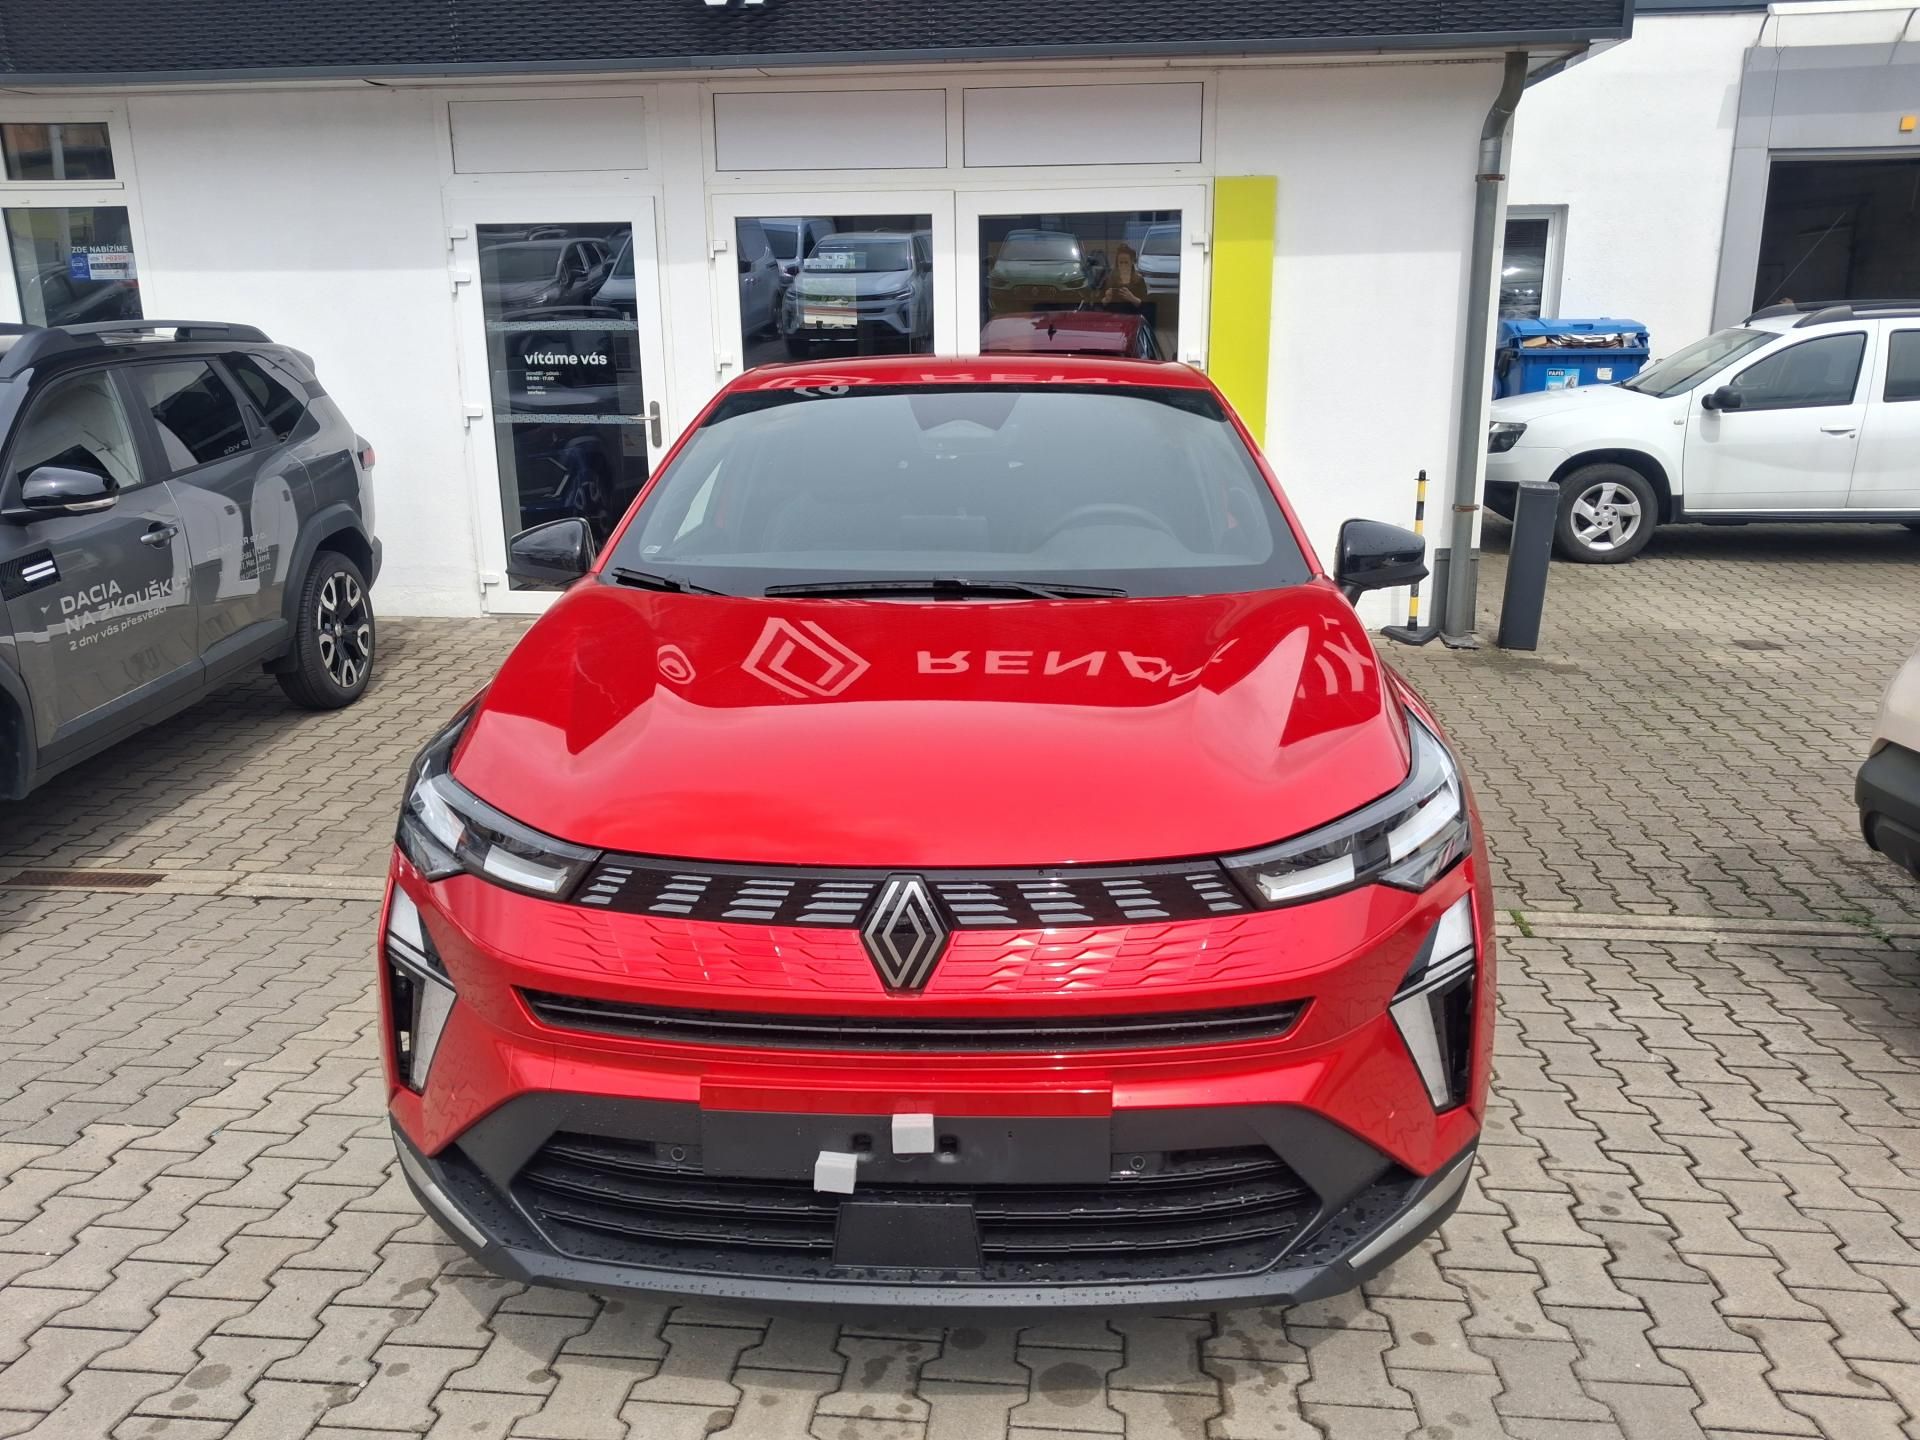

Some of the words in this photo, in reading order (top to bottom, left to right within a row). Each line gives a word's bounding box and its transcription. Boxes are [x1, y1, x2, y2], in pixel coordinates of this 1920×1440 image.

[90, 244, 128, 253] NABÍZÍME
[525, 352, 578, 365] vítáme
[580, 352, 607, 365] vás
[60, 579, 122, 615] DACIA
[64, 610, 96, 635] NA
[69, 640, 78, 651] 2
[79, 633, 99, 648] dny
[100, 626, 119, 639] vás
